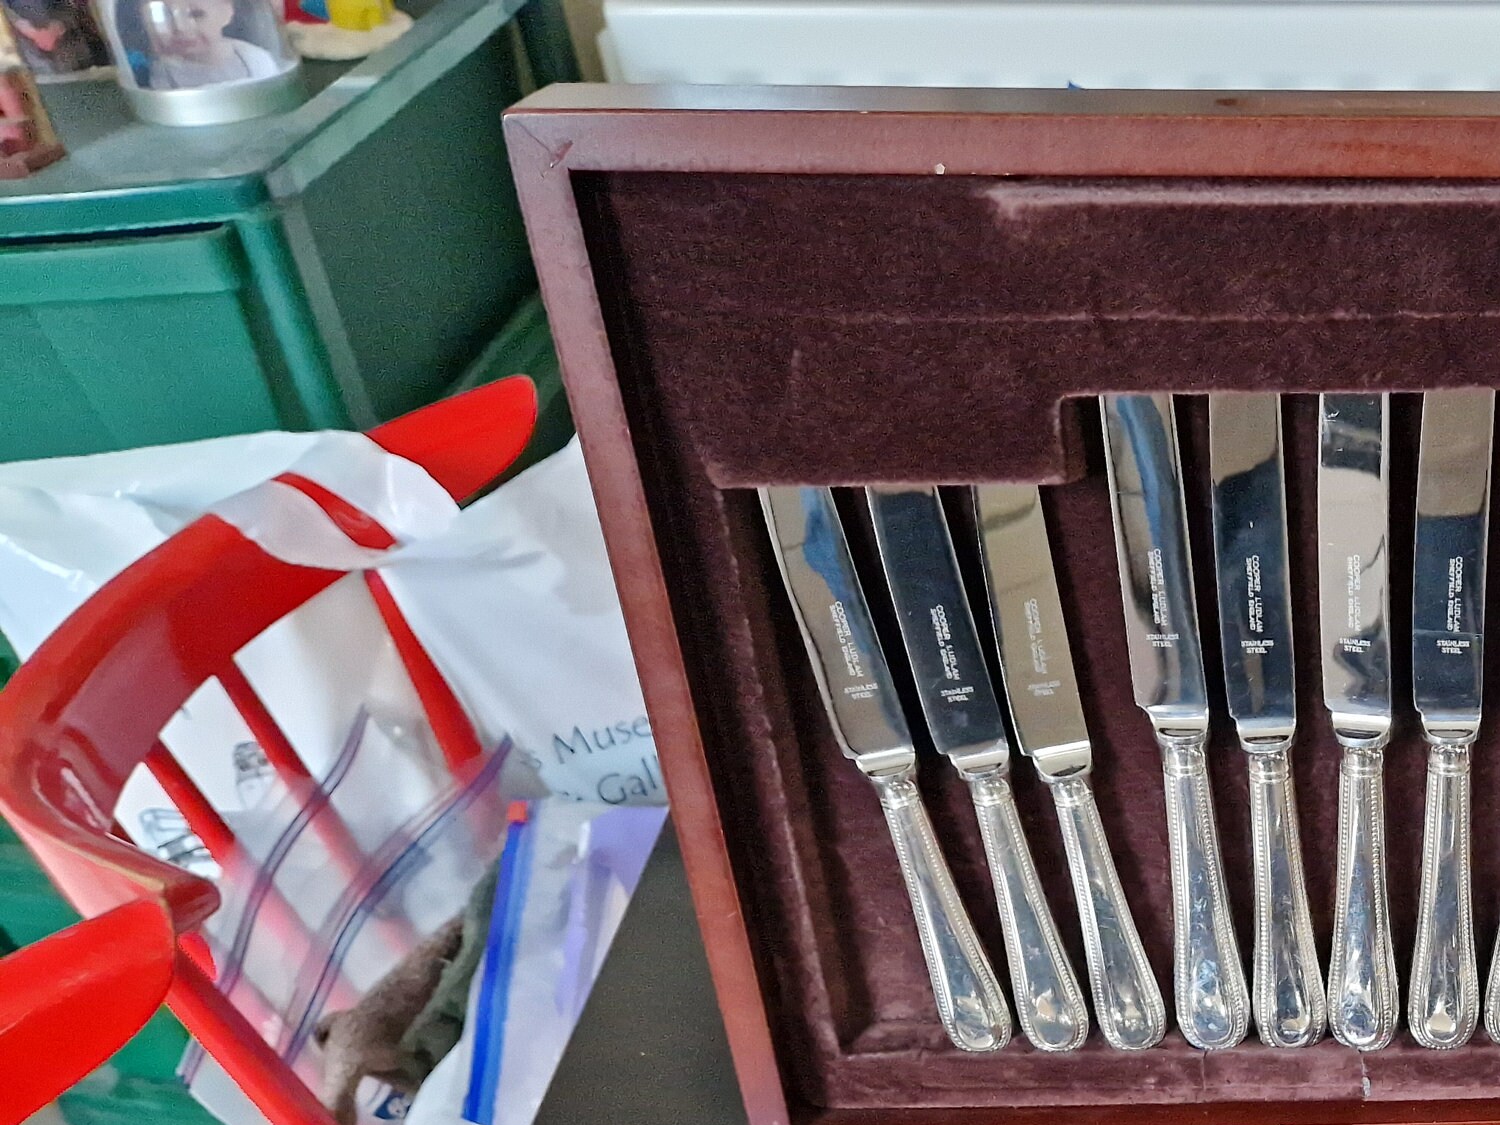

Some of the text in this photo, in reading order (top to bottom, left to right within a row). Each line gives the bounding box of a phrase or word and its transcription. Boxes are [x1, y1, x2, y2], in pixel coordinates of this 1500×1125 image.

[1154, 548, 1168, 626] COOPER LUDLAM
[1252, 555, 1263, 632] COOPER LUDLAM
[835, 601, 864, 677] COOPER LUDLAM
[936, 604, 960, 680] COOPER LUDLAM
[552, 716, 652, 765] Muse
